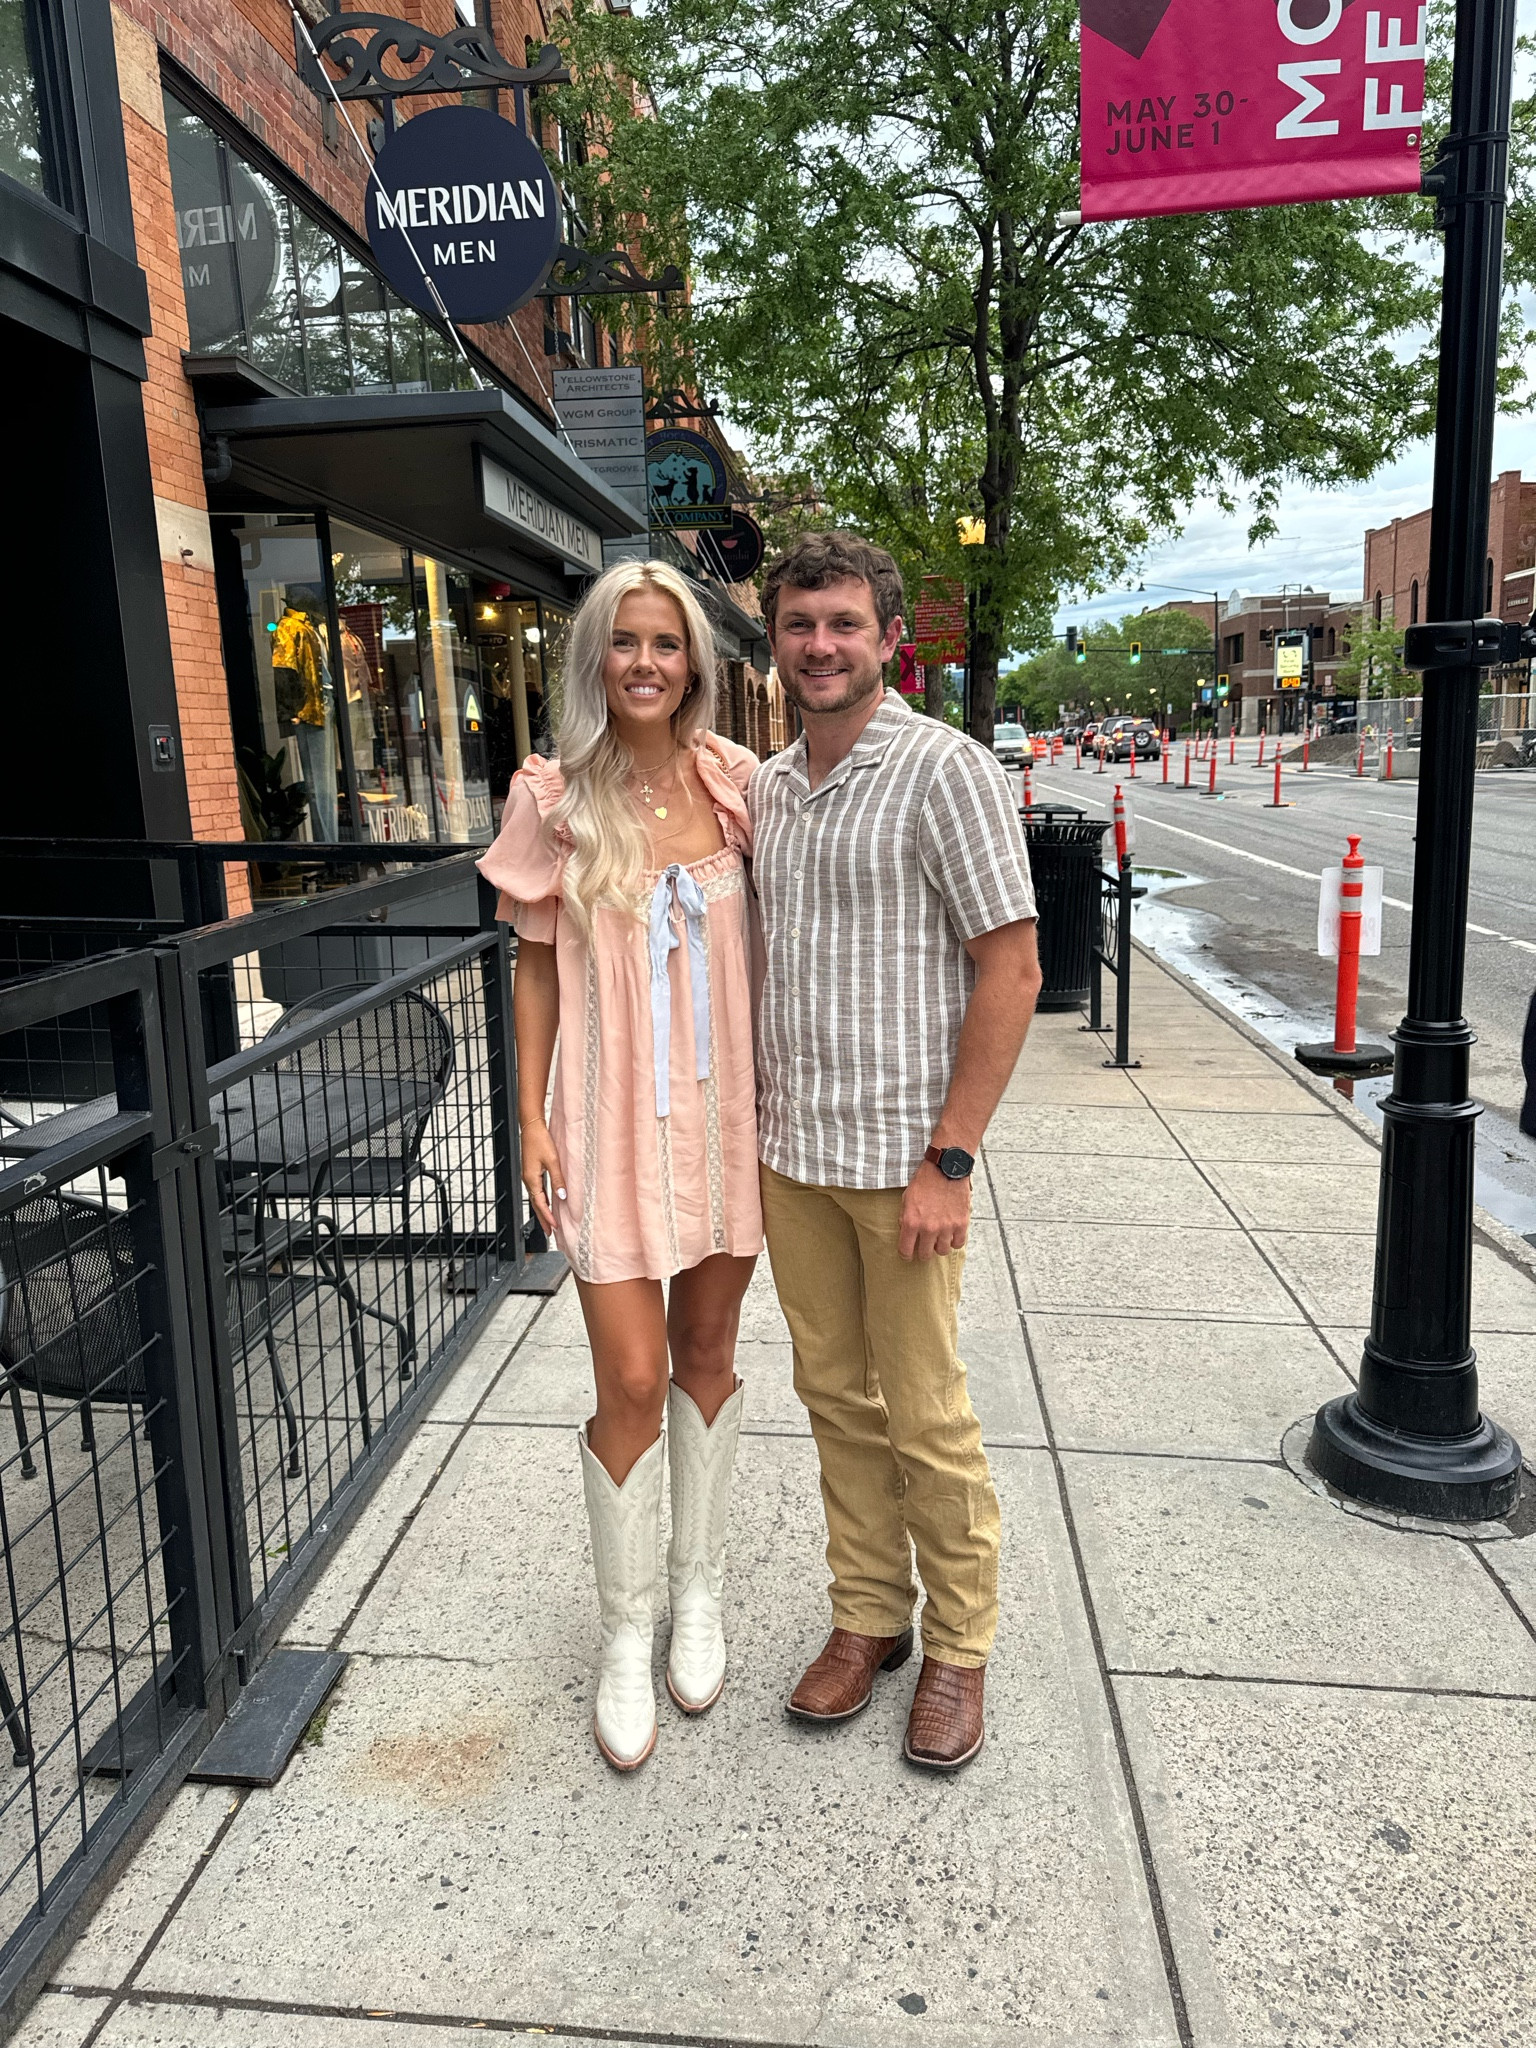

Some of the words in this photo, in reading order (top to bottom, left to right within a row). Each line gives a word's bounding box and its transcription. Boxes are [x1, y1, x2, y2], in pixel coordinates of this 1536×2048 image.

[1107, 95, 1177, 126] MAY
[1193, 90, 1249, 118] 30-
[1106, 123, 1195, 156] JUNE
[1211, 121, 1221, 145] 1
[375, 179, 545, 230] MERIDIAN
[433, 240, 496, 266] MEN
[560, 374, 636, 384] YELLOWSTONE
[566, 383, 630, 393] ARCHITECTS
[562, 410, 594, 419] WGM
[597, 408, 637, 418] GROUP
[506, 477, 565, 546] MERIDIAN
[567, 519, 590, 560] MEN
[663, 510, 724, 524] COMPANY
